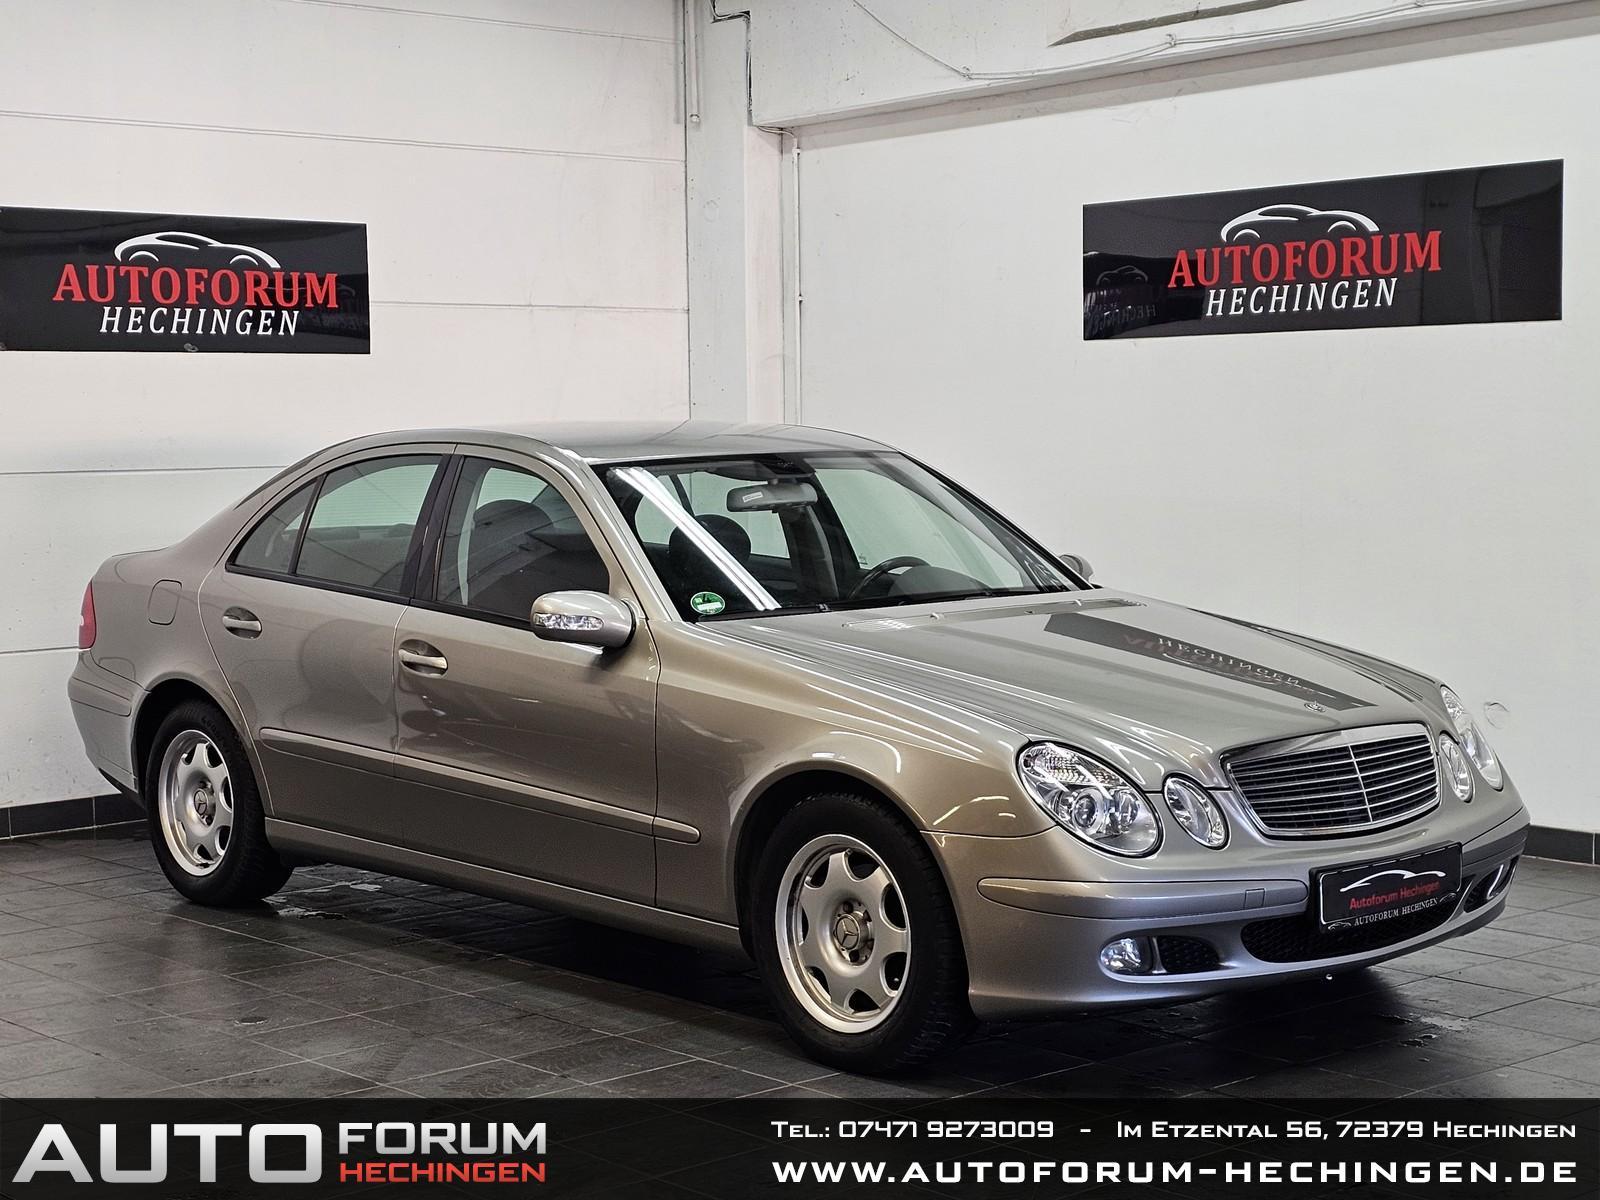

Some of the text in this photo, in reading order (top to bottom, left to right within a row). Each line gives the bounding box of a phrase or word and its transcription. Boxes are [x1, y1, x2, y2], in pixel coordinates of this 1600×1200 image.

[1168, 231, 1441, 289] AUTOFORUM
[53, 263, 338, 309] AUTOFORUM
[1206, 277, 1398, 316] HECHINGEN
[99, 305, 299, 336] HECHINGEN
[1349, 881, 1440, 910] Autoforum Hechingen
[1354, 897, 1438, 926] AUTOFORUM HECHINGEN
